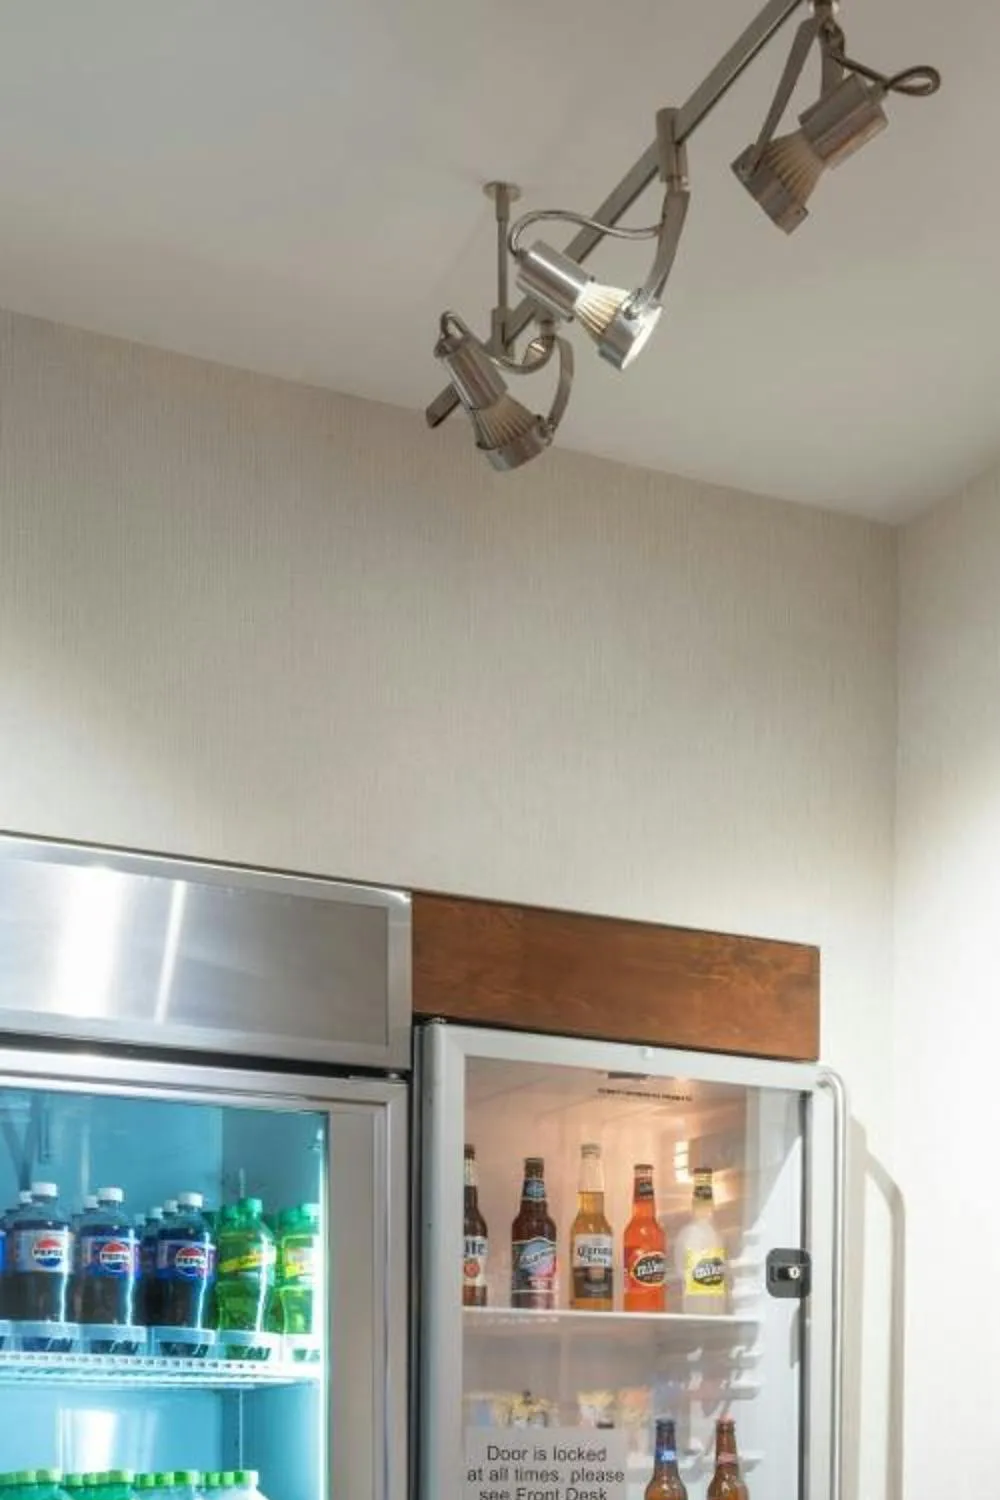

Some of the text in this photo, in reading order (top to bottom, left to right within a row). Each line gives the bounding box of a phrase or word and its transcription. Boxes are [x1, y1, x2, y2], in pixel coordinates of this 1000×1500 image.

[487, 1445, 607, 1461] Door is locked
[467, 1468, 484, 1482] at
[489, 1468, 509, 1482] all
[570, 1468, 625, 1484] please
